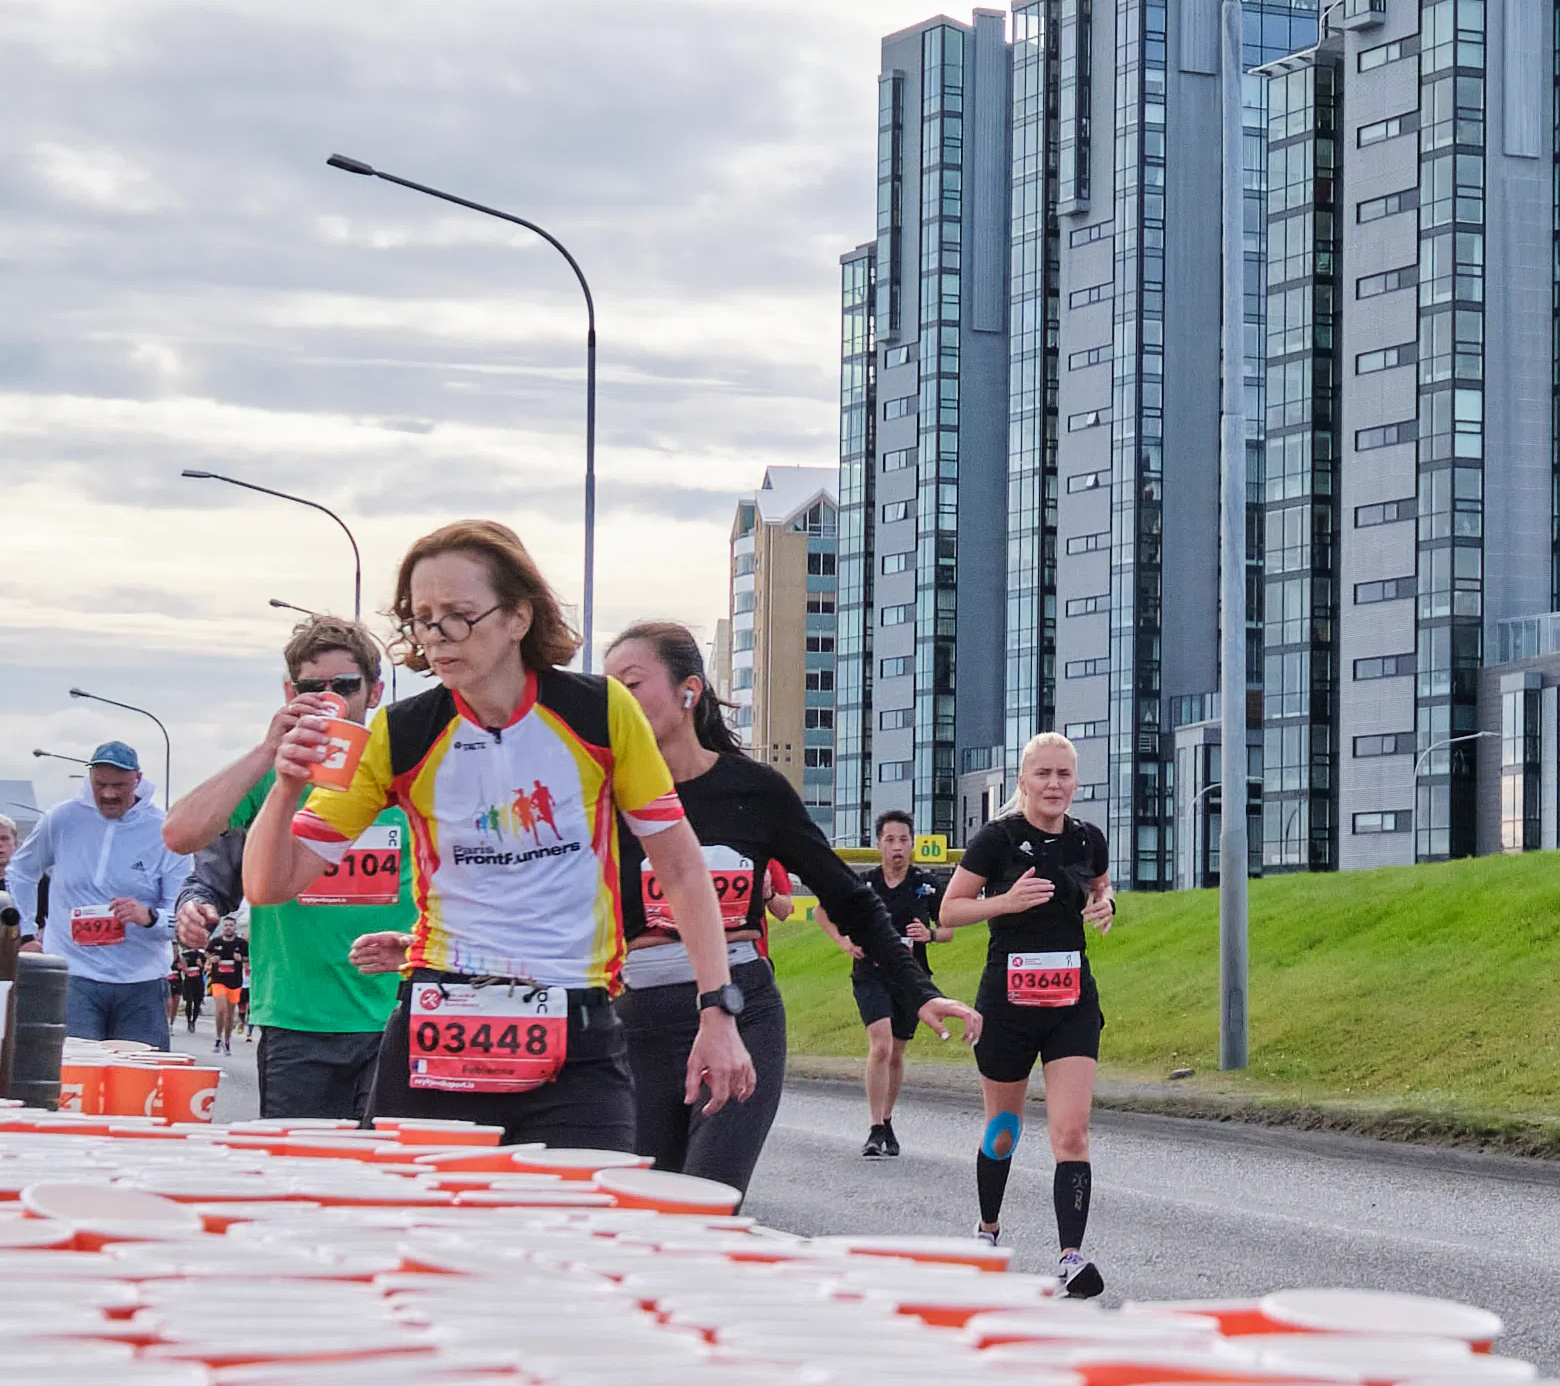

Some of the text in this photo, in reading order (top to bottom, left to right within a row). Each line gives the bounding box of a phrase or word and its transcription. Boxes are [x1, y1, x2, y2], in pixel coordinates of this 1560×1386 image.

[453, 841, 494, 855] Paris
[647, 875, 750, 901] 099
[1011, 972, 1073, 989] 03646
[416, 1021, 548, 1056] 03448
